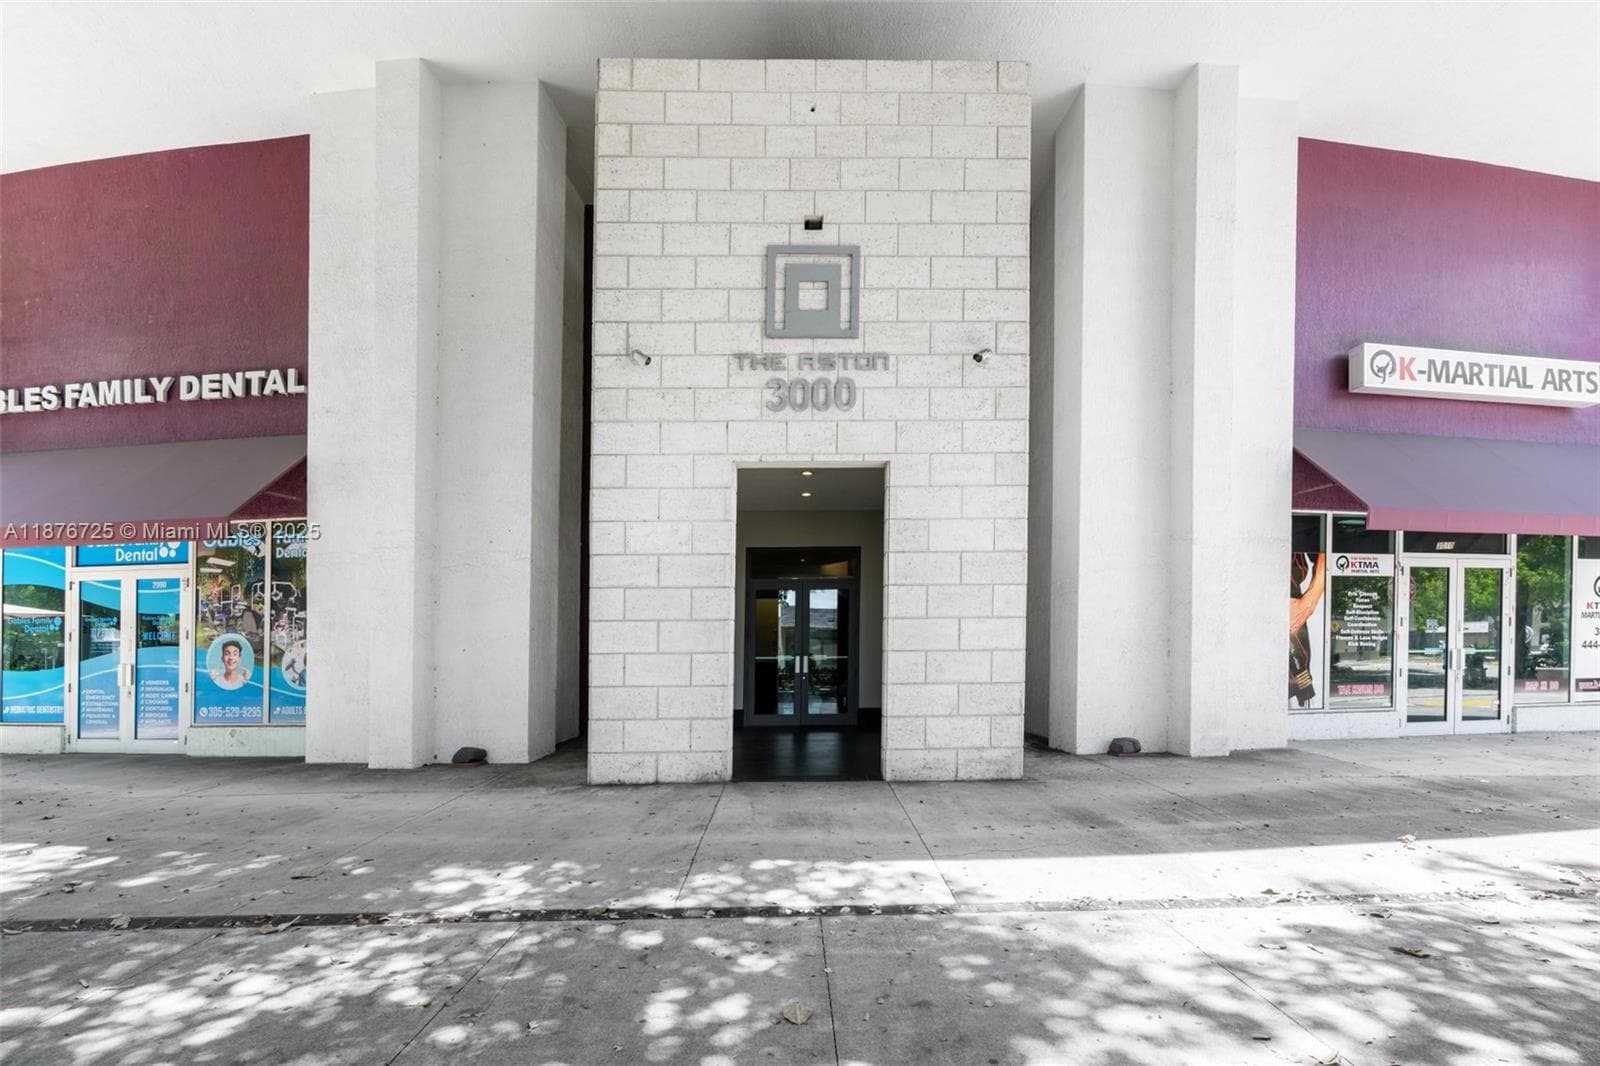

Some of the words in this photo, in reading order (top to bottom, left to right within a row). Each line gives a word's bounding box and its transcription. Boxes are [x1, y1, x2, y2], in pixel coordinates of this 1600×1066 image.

[733, 353, 786, 371] THE
[1398, 356, 1534, 390] K-MARTIAL
[1541, 368, 1599, 394] ARTS
[65, 375, 173, 409] FAMILY
[180, 368, 307, 402] DENTAL
[766, 377, 857, 412] 3000
[115, 547, 158, 561] Dental
[1351, 561, 1379, 569] KTMA
